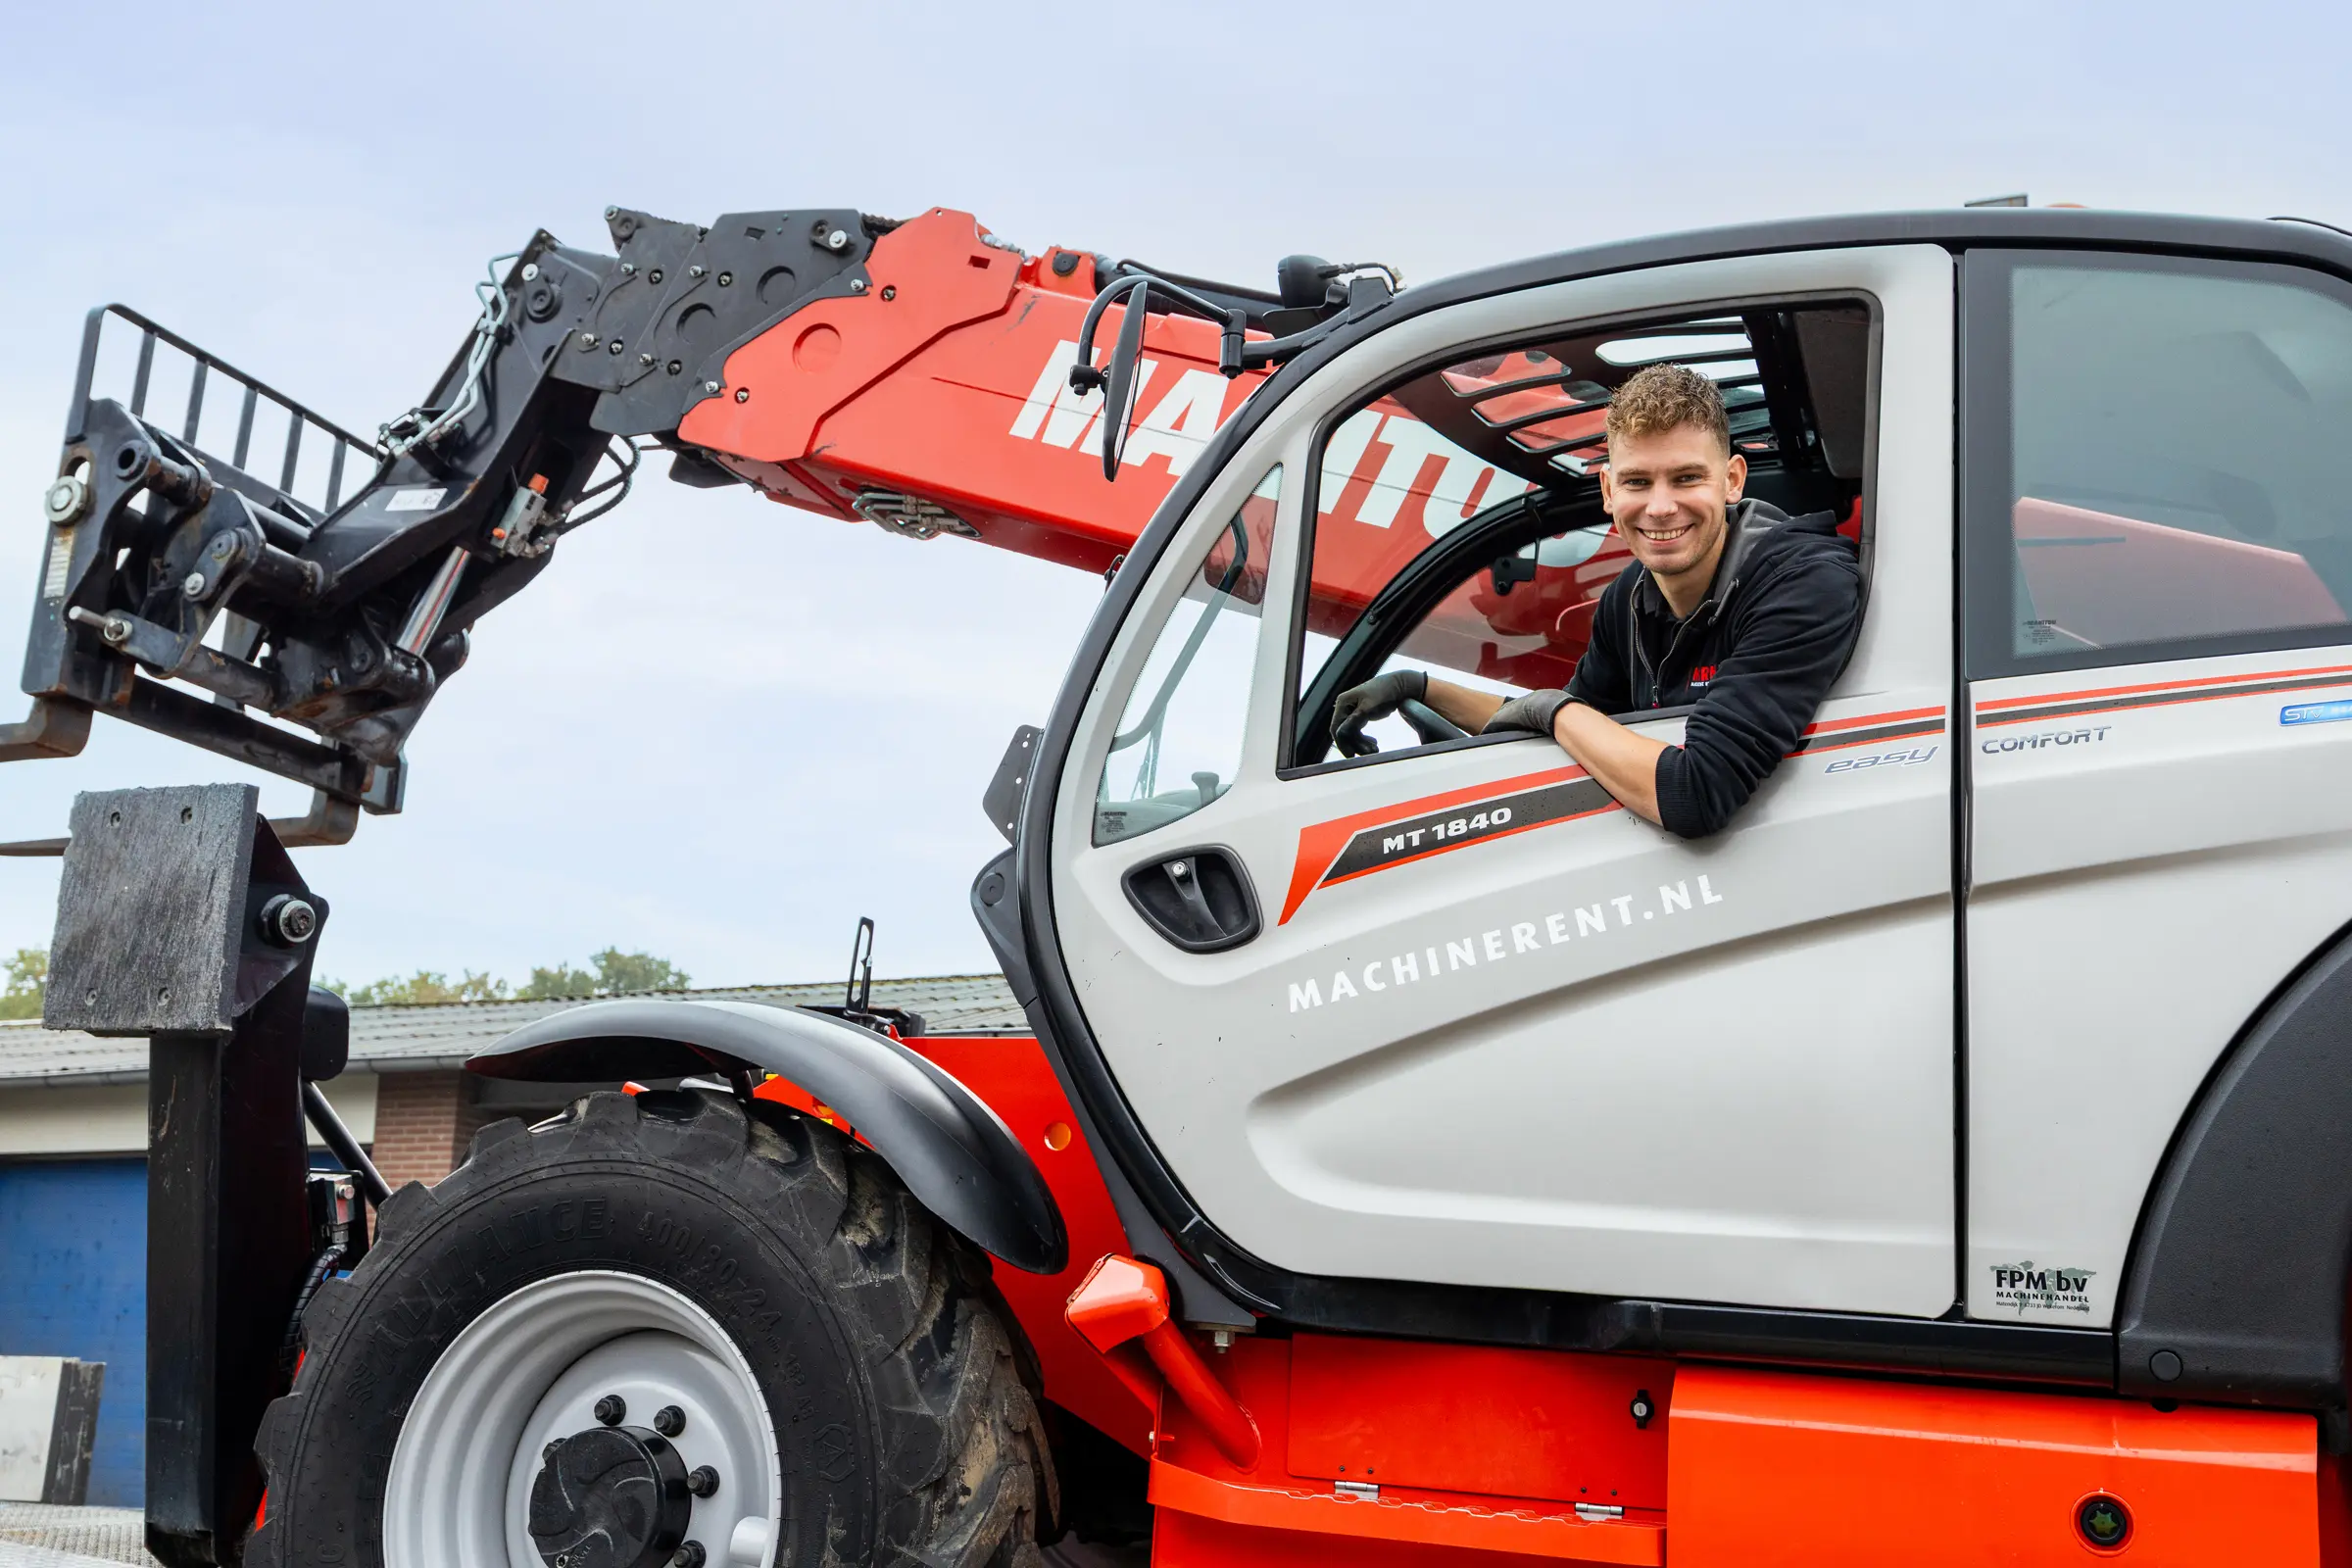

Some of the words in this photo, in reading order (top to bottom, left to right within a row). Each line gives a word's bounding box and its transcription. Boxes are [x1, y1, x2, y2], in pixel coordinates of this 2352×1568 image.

[1982, 725, 2112, 755] COMFORT
[1825, 745, 1939, 774] easy
[1383, 826, 1426, 855] MT
[1432, 807, 1512, 841] 1840
[1289, 874, 1723, 1013] MACHINERENT.NL
[1995, 1269, 2048, 1291] FPM
[2056, 1270, 2088, 1293] bv
[1995, 1291, 2089, 1303] MACHINEHANDEL
